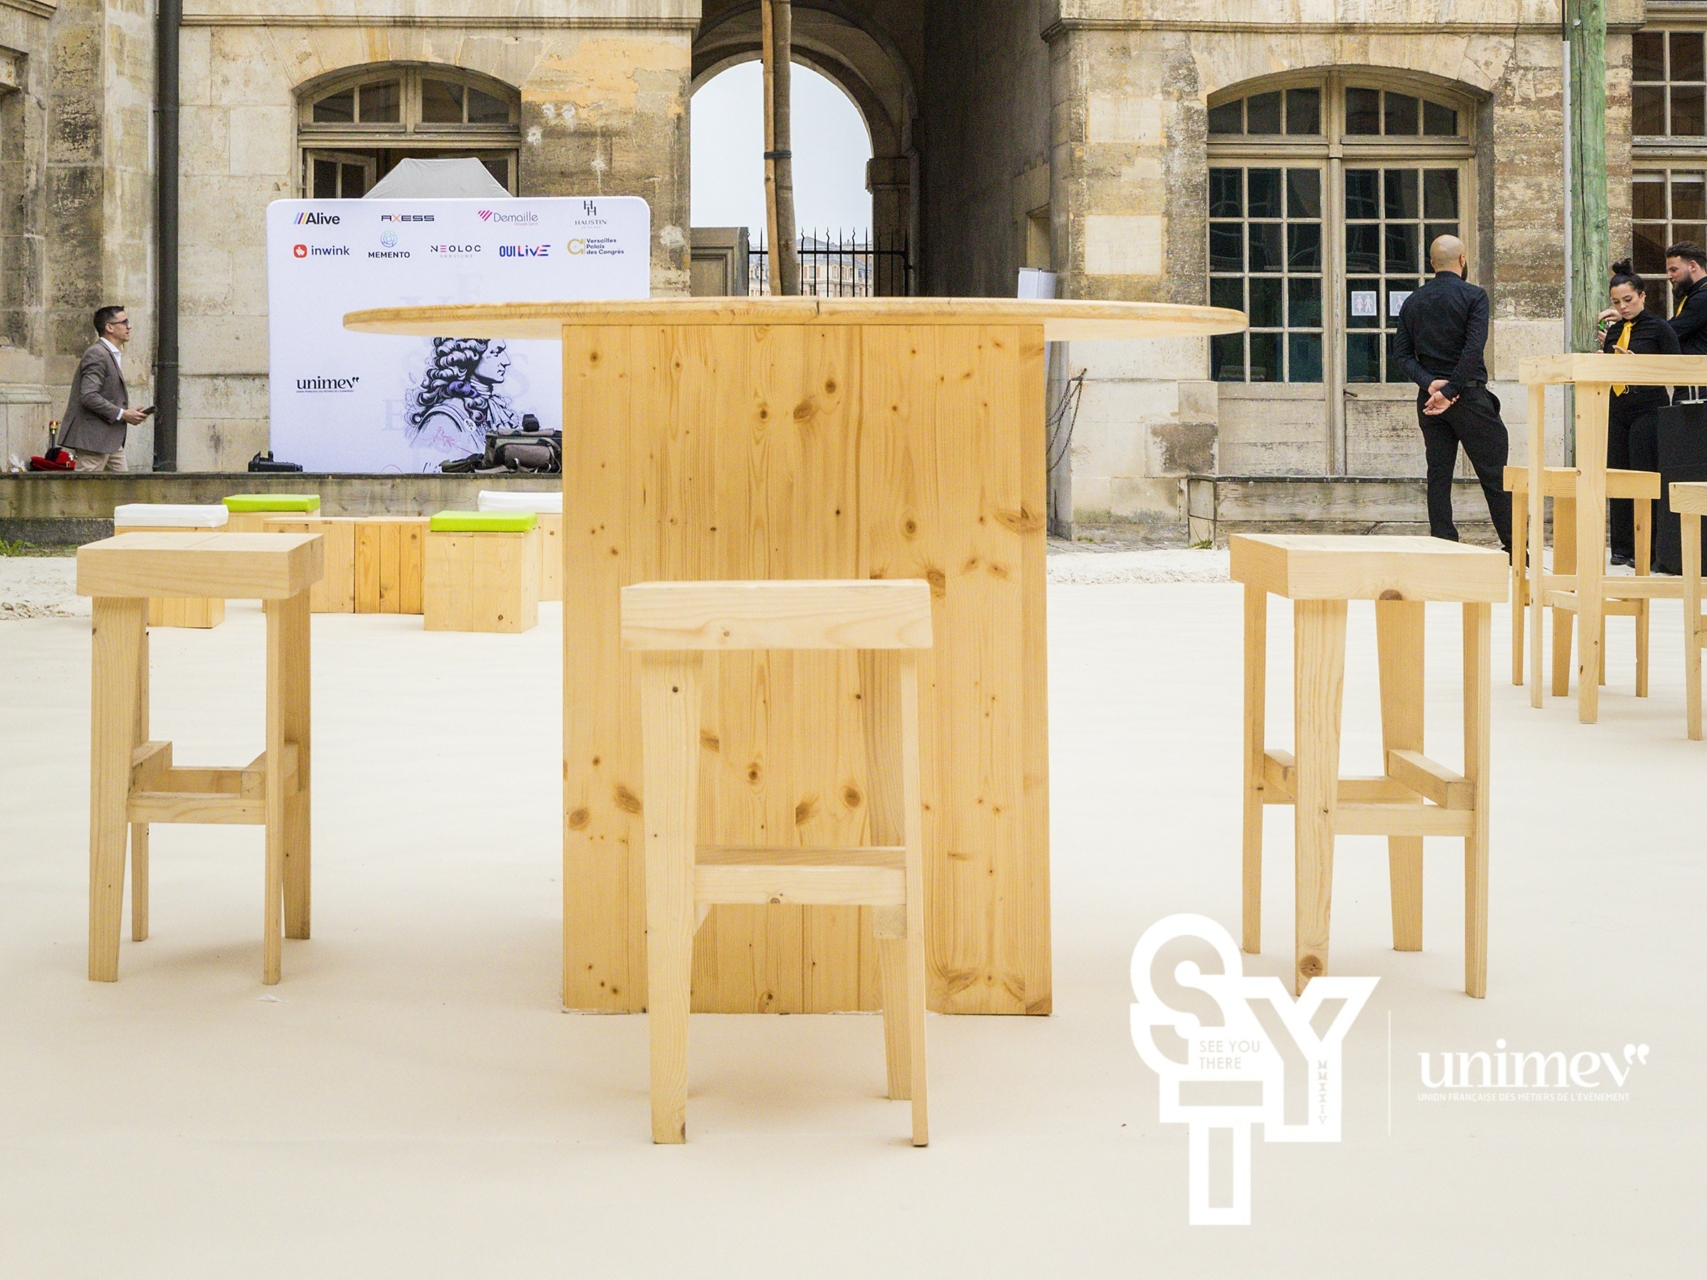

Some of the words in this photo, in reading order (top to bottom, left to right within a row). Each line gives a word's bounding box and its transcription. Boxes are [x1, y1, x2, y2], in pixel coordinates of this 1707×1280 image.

[493, 211, 539, 222] Demaille
[311, 245, 350, 256] inwink
[430, 245, 482, 253] NEOLOC
[368, 251, 411, 259] MEMENTO
